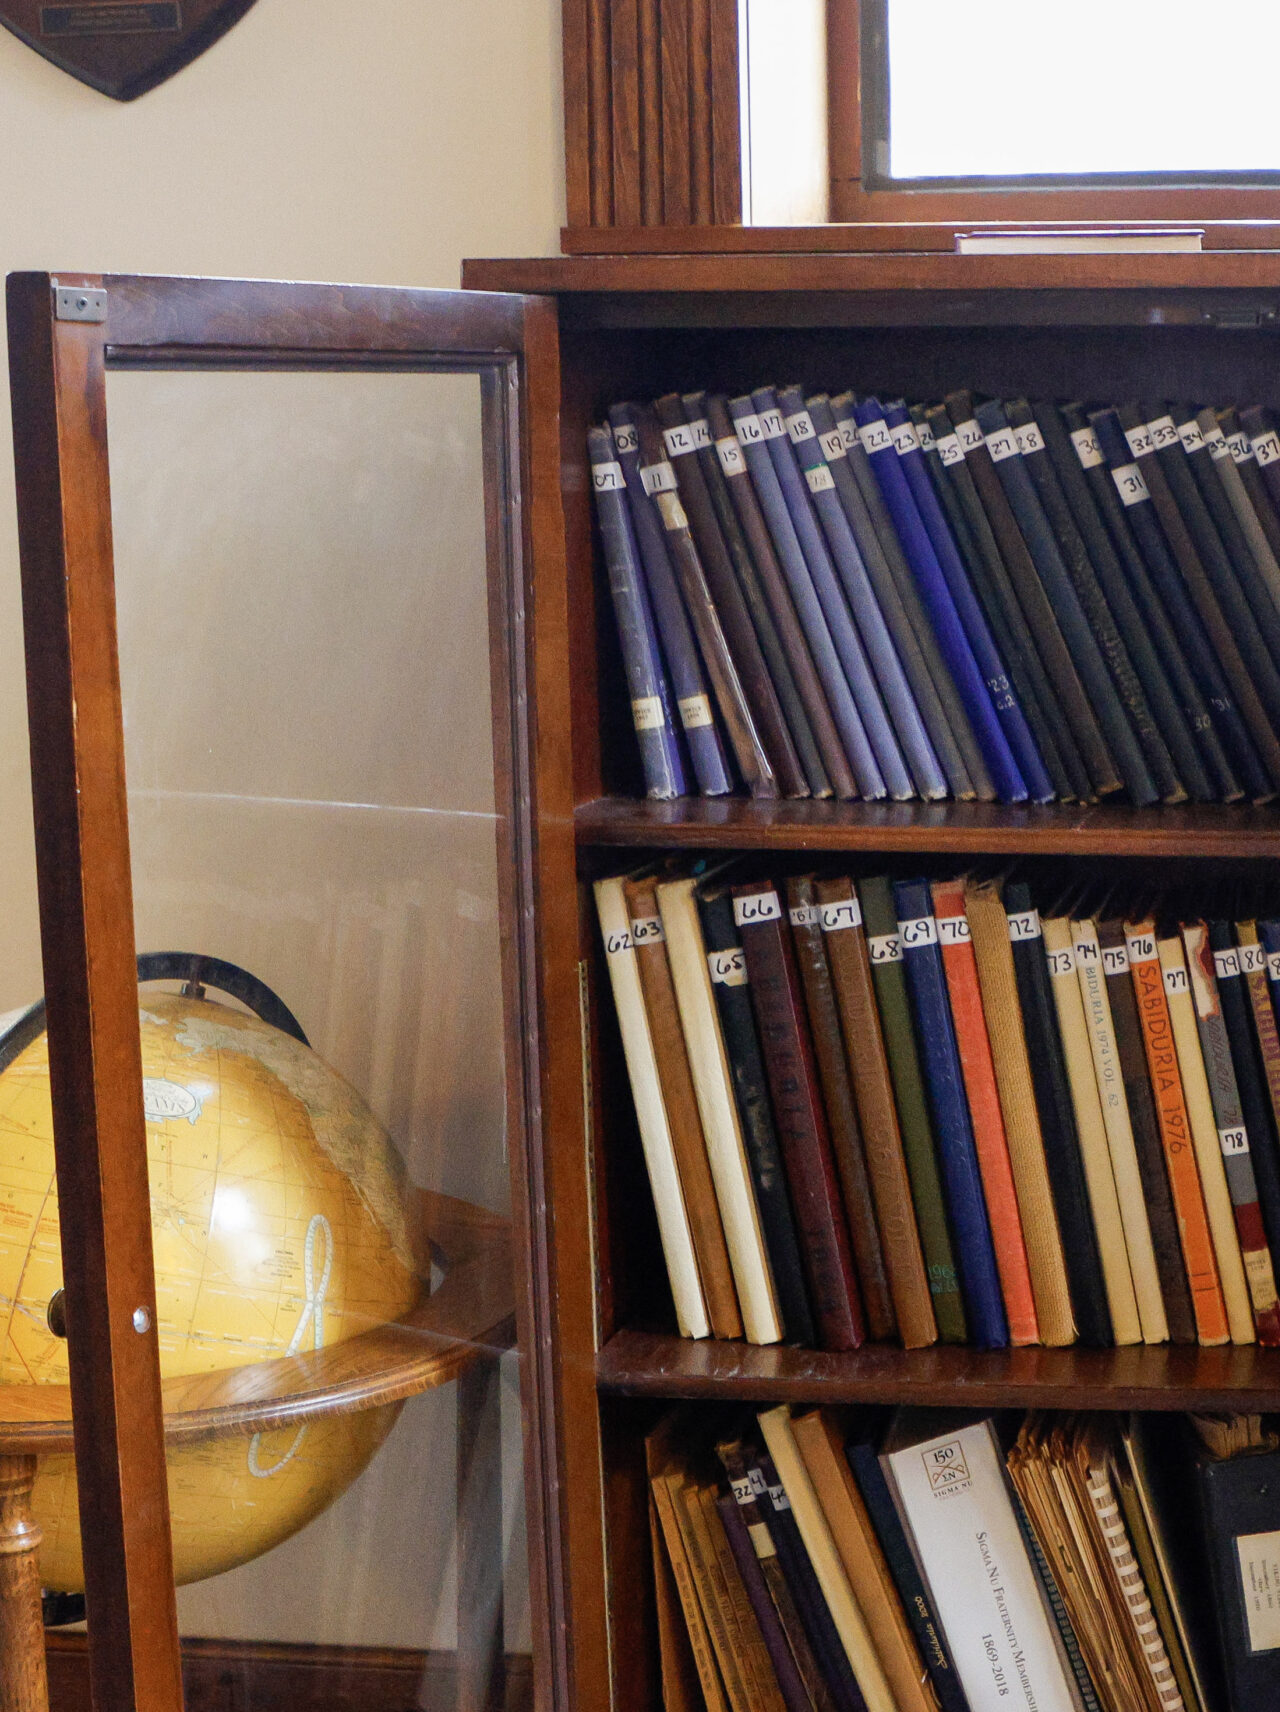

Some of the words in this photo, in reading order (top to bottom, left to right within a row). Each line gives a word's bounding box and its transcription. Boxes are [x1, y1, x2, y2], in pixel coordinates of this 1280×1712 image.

[763, 416, 783, 432] 17
[793, 421, 809, 435] 18
[616, 431, 638, 449] 08
[670, 433, 689, 447] 12
[697, 428, 711, 441] 14
[742, 426, 760, 440] 16
[868, 431, 889, 447] 22
[963, 432, 984, 443] 26
[1018, 433, 1036, 449] 28
[1153, 426, 1177, 443] 33
[1183, 432, 1203, 445] 34
[827, 437, 842, 451] 19
[895, 435, 914, 449] 23
[992, 439, 1010, 454] 27
[1132, 437, 1152, 451] 32
[1208, 440, 1226, 452] 35
[1229, 442, 1249, 457] 36
[1258, 440, 1277, 460] 37
[722, 451, 737, 461] 15
[941, 443, 958, 460] 25
[595, 472, 616, 487] 07
[1124, 476, 1143, 492] 31
[987, 675, 1009, 692] '23
[743, 900, 773, 918] 66
[824, 907, 852, 927] 67
[635, 922, 660, 938] 63
[904, 922, 930, 942] 69
[942, 922, 969, 938] 70
[1010, 919, 1033, 935] 72
[608, 935, 634, 953] 62
[872, 941, 898, 959] 68
[1077, 944, 1097, 958] 74
[1131, 940, 1152, 954] 76
[717, 954, 744, 975] 65
[1048, 953, 1072, 972] 73
[1104, 952, 1125, 968] 75
[1216, 957, 1238, 975] 79
[1245, 950, 1264, 969] 80
[1167, 972, 1186, 987] 77
[1096, 1030, 1111, 1054] 1974
[1107, 1094, 1120, 1106] 62
[1137, 967, 1177, 1092] SABIDURIA
[1162, 1106, 1189, 1154] 1976
[1225, 1132, 1243, 1149] 78
[933, 1448, 954, 1464] 150
[942, 1473, 956, 1482] ΣN
[734, 1487, 752, 1499] 32
[933, 1485, 961, 1498] SIGMA
[962, 1480, 973, 1489] NU
[975, 1532, 997, 1566] SIGMA
[985, 1566, 1003, 1586] NU
[991, 1586, 1022, 1649] FRATERNITY
[979, 1633, 1010, 1696] 1869-2018
